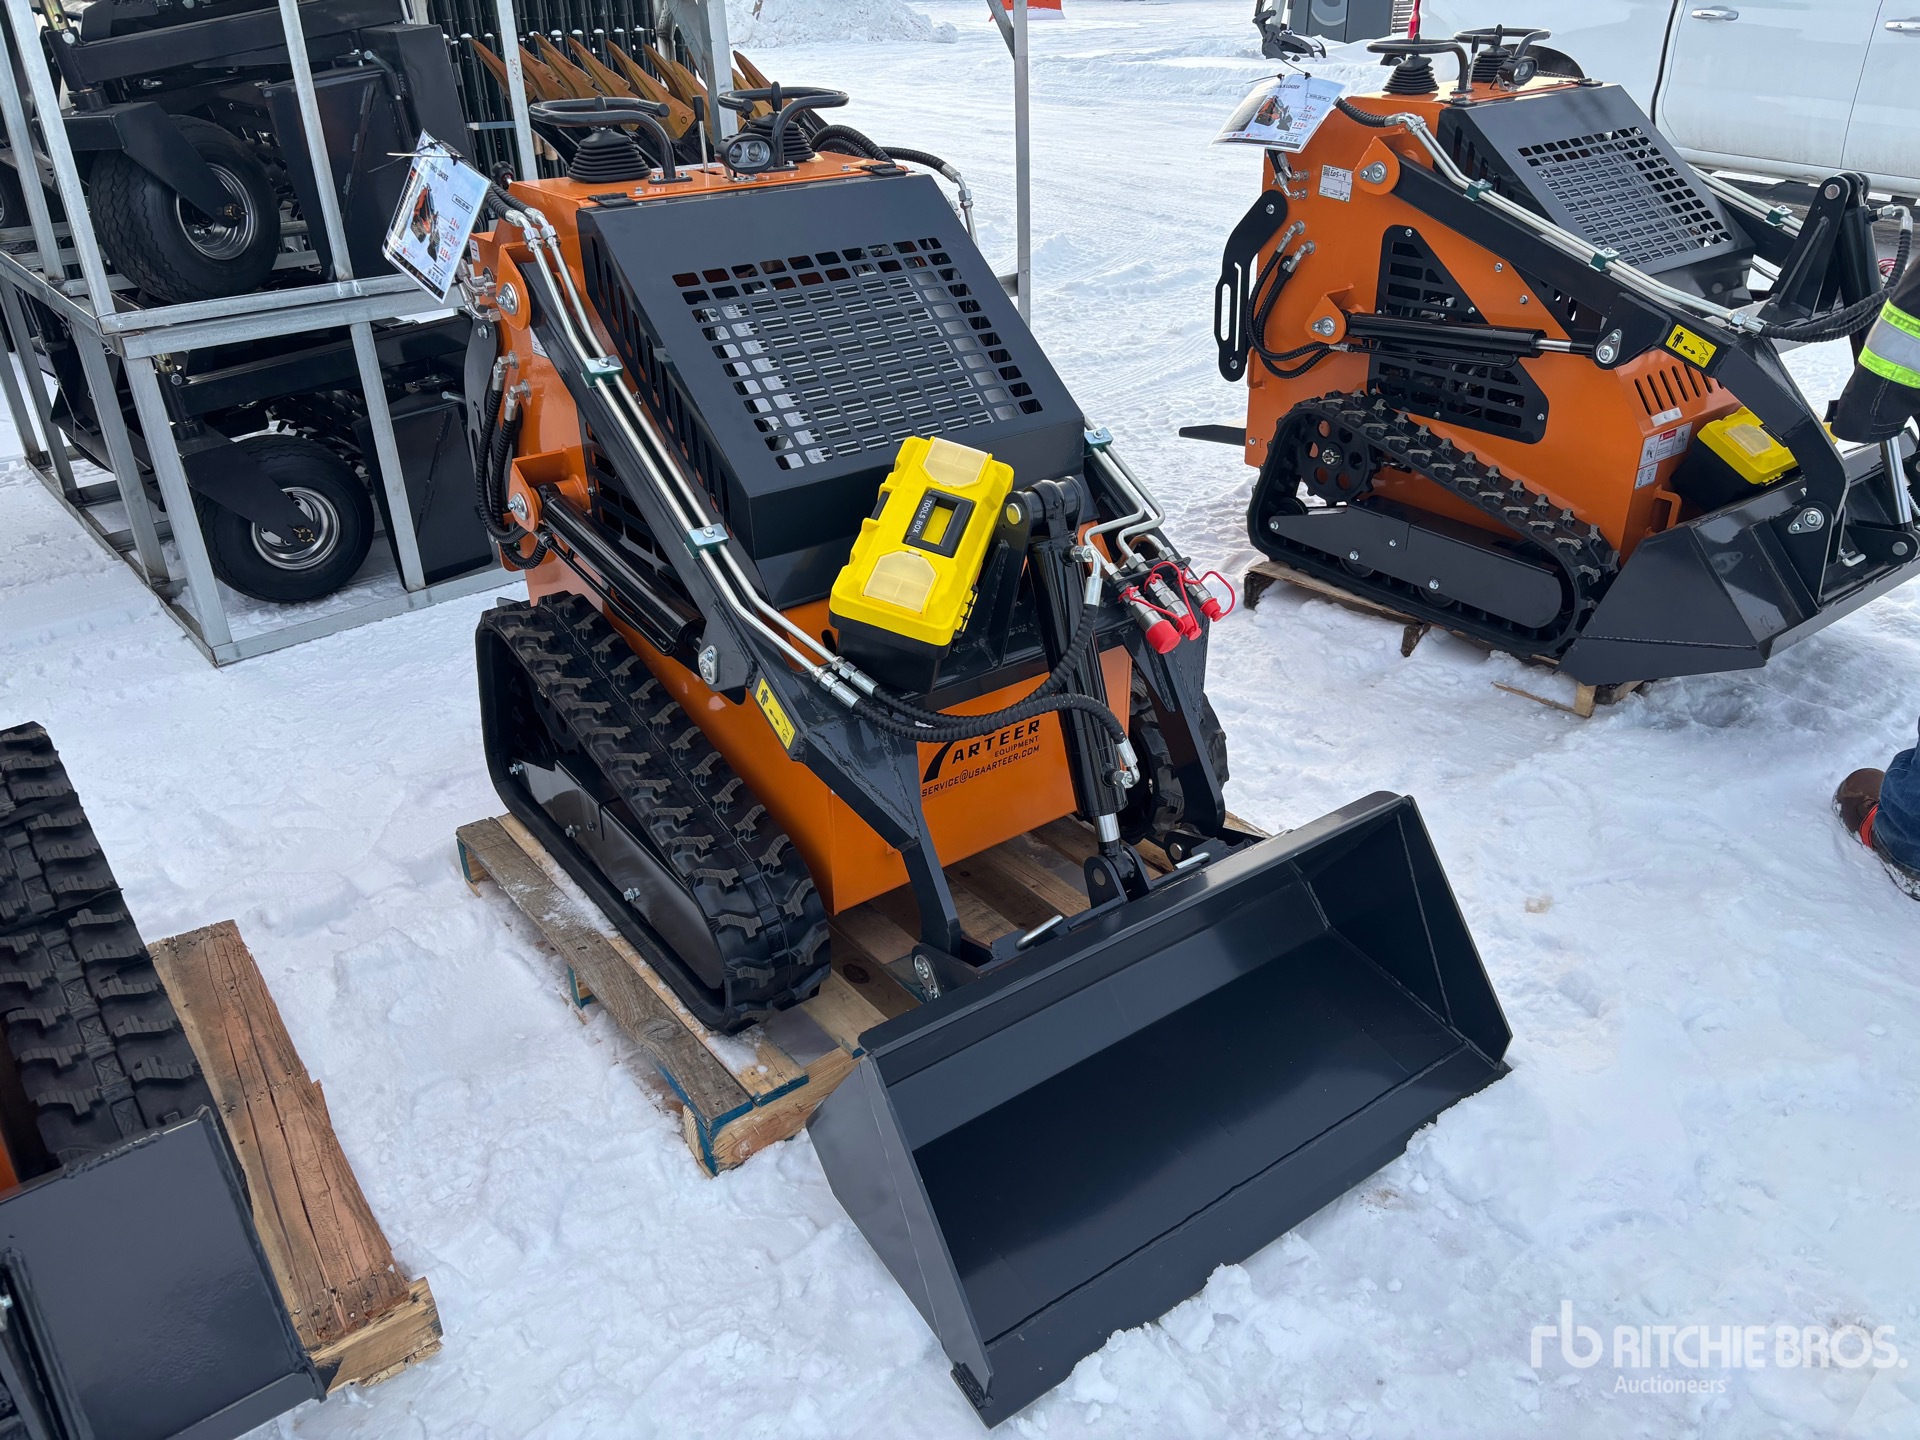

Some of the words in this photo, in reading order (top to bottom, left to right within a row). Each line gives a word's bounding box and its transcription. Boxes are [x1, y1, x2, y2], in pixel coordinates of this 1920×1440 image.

[918, 499, 932, 519] TOOLS
[912, 520, 923, 534] BOX
[952, 719, 1040, 764] ARTEER
[994, 735, 1039, 758] EQUIPMENT
[922, 744, 1040, 797] SERVICE@USAARTEER.COM
